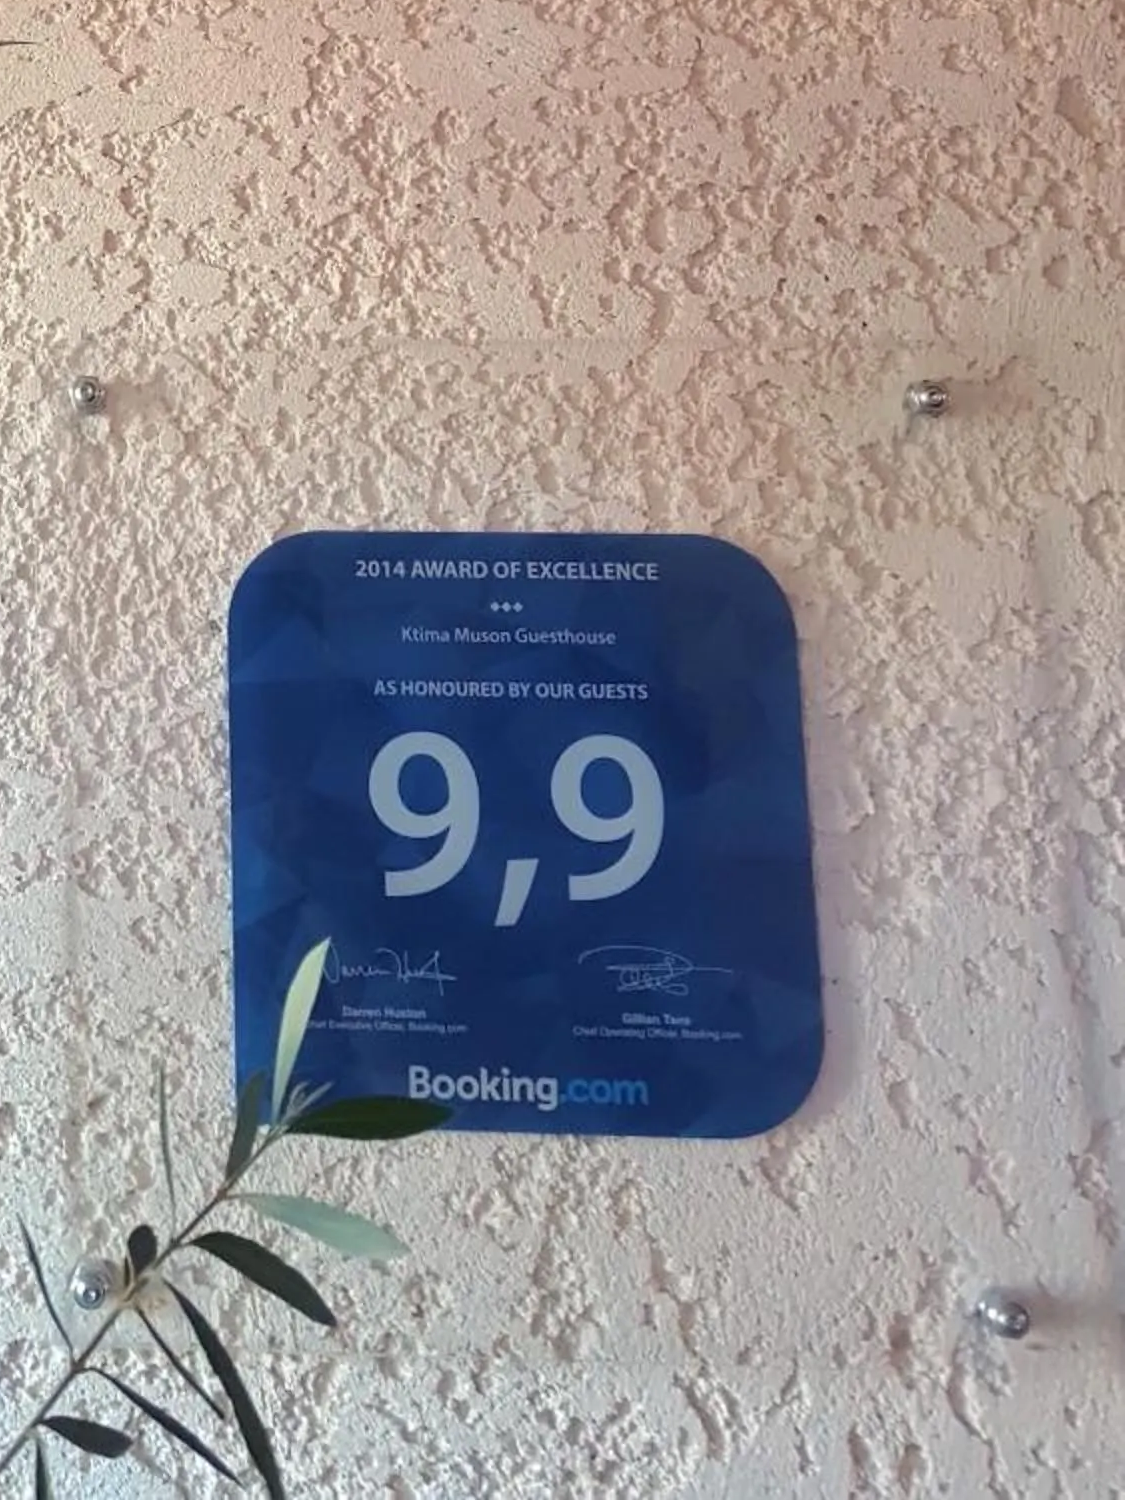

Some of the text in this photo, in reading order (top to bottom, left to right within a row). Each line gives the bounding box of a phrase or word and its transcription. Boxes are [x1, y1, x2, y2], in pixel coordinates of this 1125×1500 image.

[355, 560, 659, 581] 2014 AWARD OF EXCELLENCE
[401, 626, 617, 645] Ktima Muson Guesthouse
[374, 680, 649, 700] AS HONOURED BY OUR GUESTS
[368, 731, 665, 927] 9,9
[342, 1005, 381, 1018] Darren
[408, 1064, 650, 1111] Booking.com
